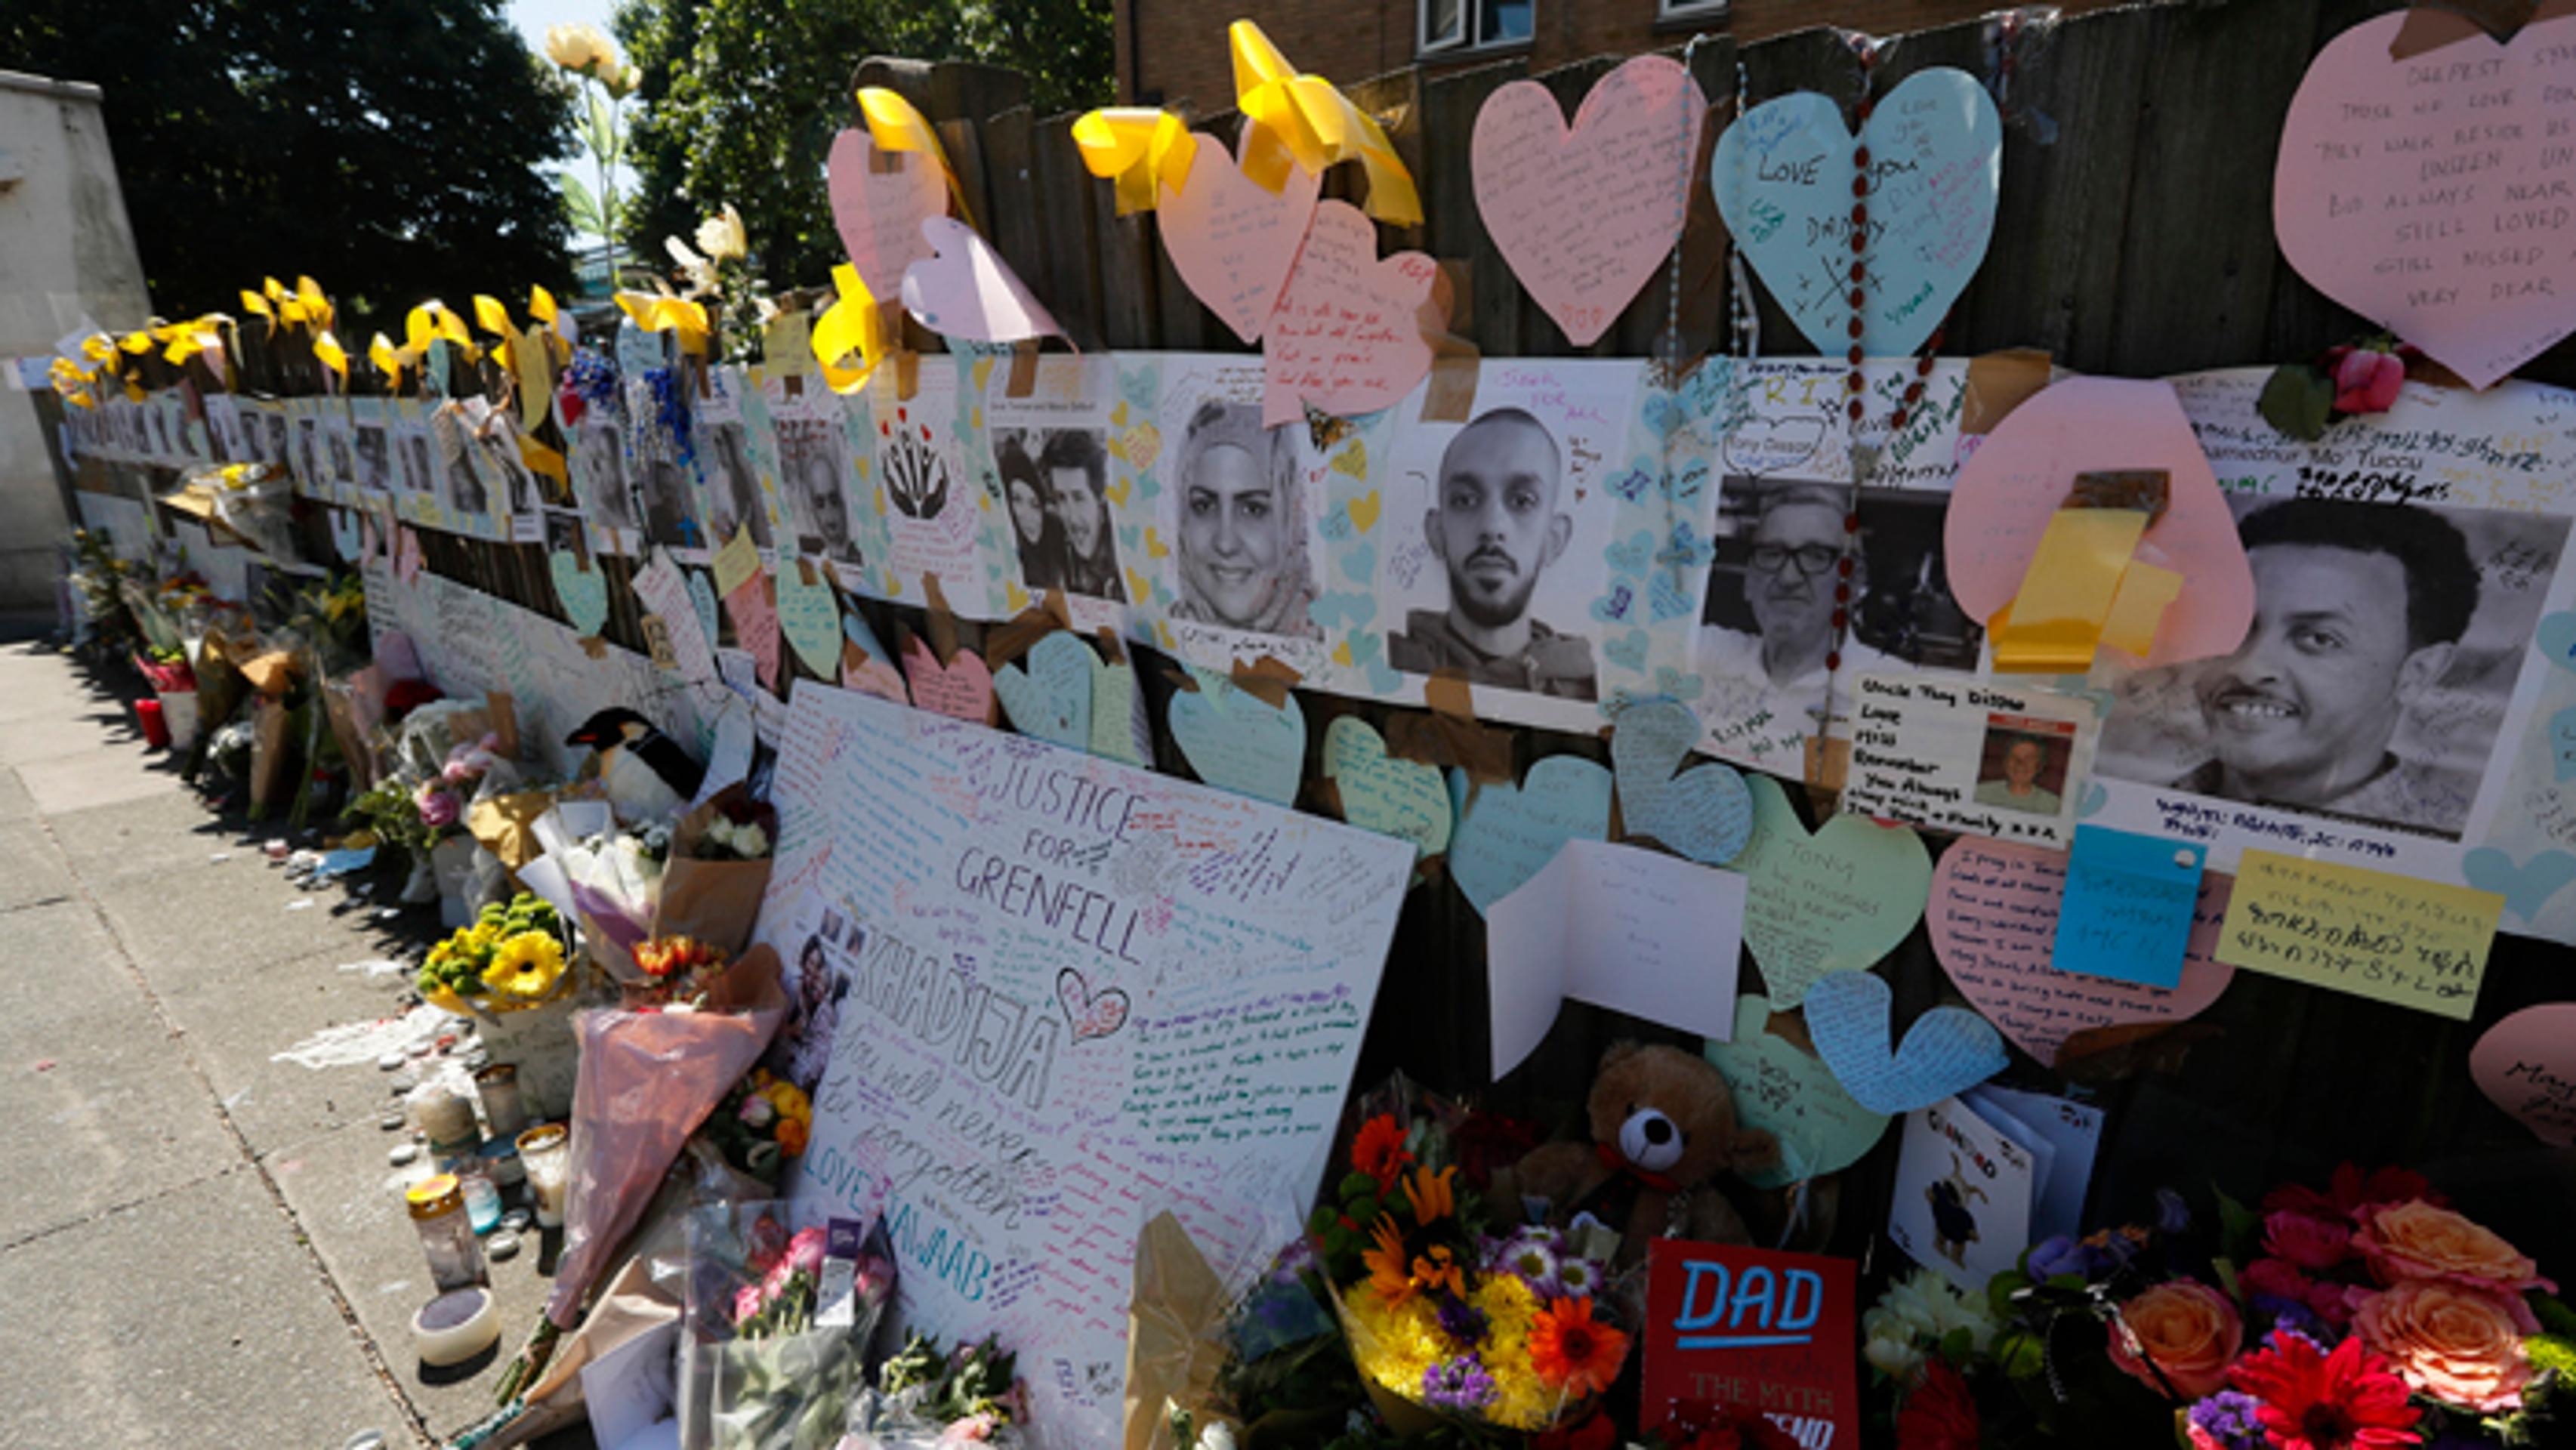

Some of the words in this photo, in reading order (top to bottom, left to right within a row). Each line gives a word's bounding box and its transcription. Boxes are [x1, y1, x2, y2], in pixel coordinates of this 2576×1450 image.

[1757, 151, 1826, 186] LOVE
[2494, 205, 2570, 234] LOVED
[1862, 677, 1911, 699] Uncle
[989, 760, 1149, 844] JUSTICE
[1023, 828, 1076, 868] FOR
[955, 846, 1142, 966] GRENFELL
[850, 923, 1060, 1111] KHADIJA
[803, 1137, 873, 1216] LOVE
[849, 1121, 1021, 1231] forgotten
[1672, 1258, 1825, 1331] DAD
[1687, 1371, 1751, 1407] THE
[1758, 1380, 1835, 1417] MYTH
